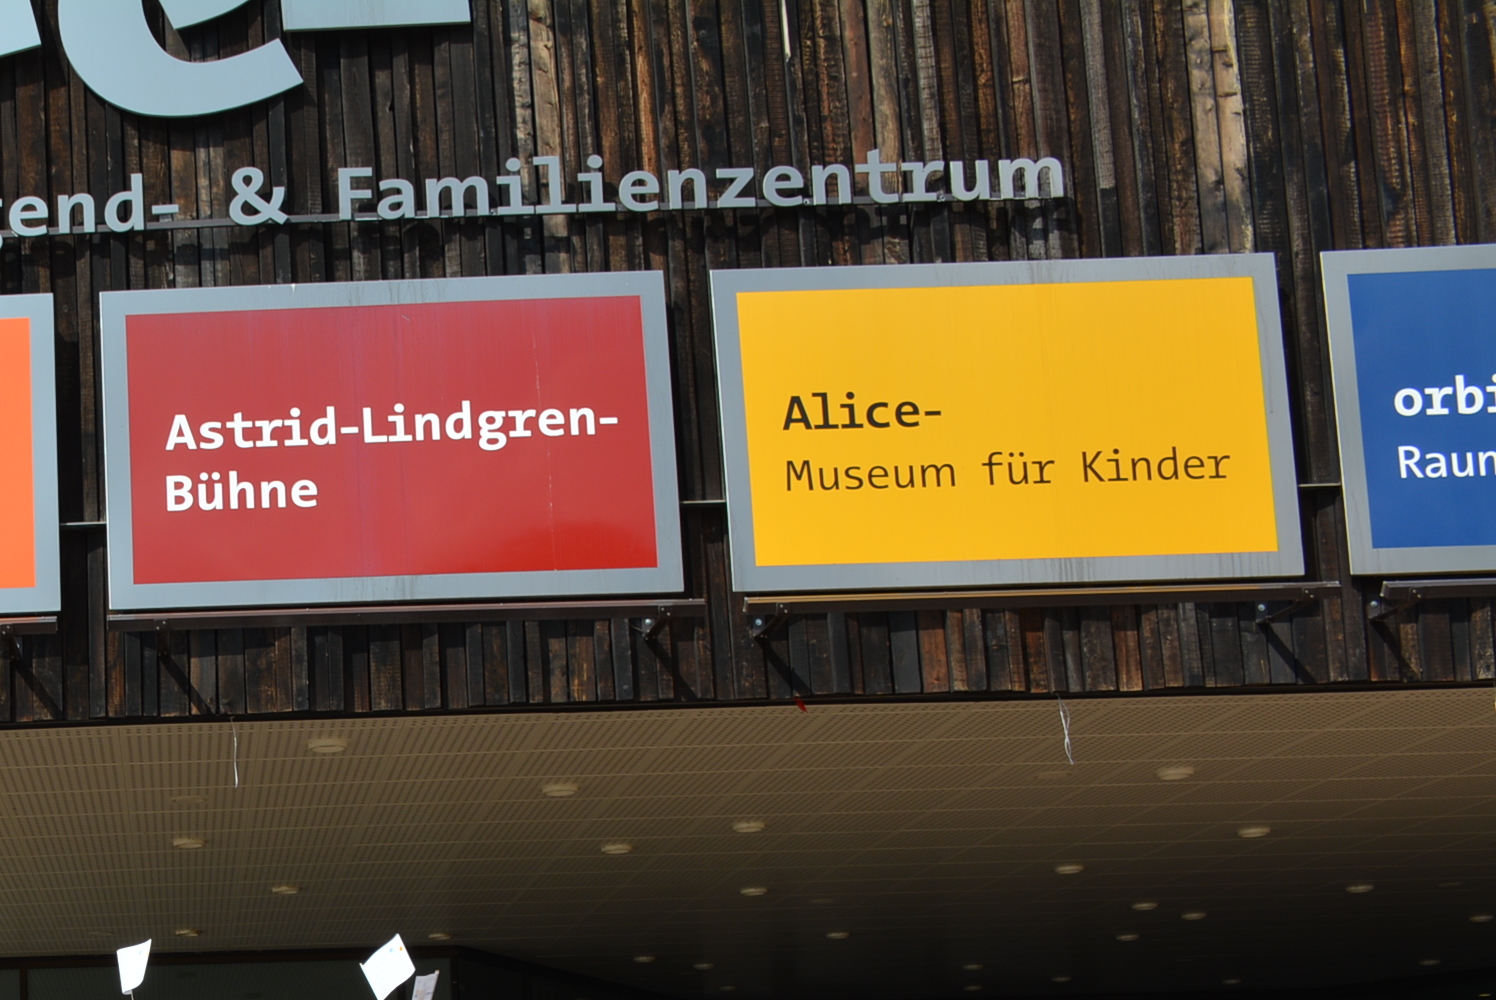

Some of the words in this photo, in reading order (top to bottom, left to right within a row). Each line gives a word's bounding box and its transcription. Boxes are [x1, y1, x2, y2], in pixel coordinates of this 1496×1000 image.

[229, 167, 288, 225] &
[338, 148, 1064, 220] Familienzentrum
[165, 400, 620, 451] Astrid-Lindgren-
[782, 391, 942, 431] Alice-
[165, 470, 318, 512] Bühne
[786, 459, 956, 492] Museum
[981, 451, 1055, 486] für
[1081, 446, 1231, 483] Kinder
